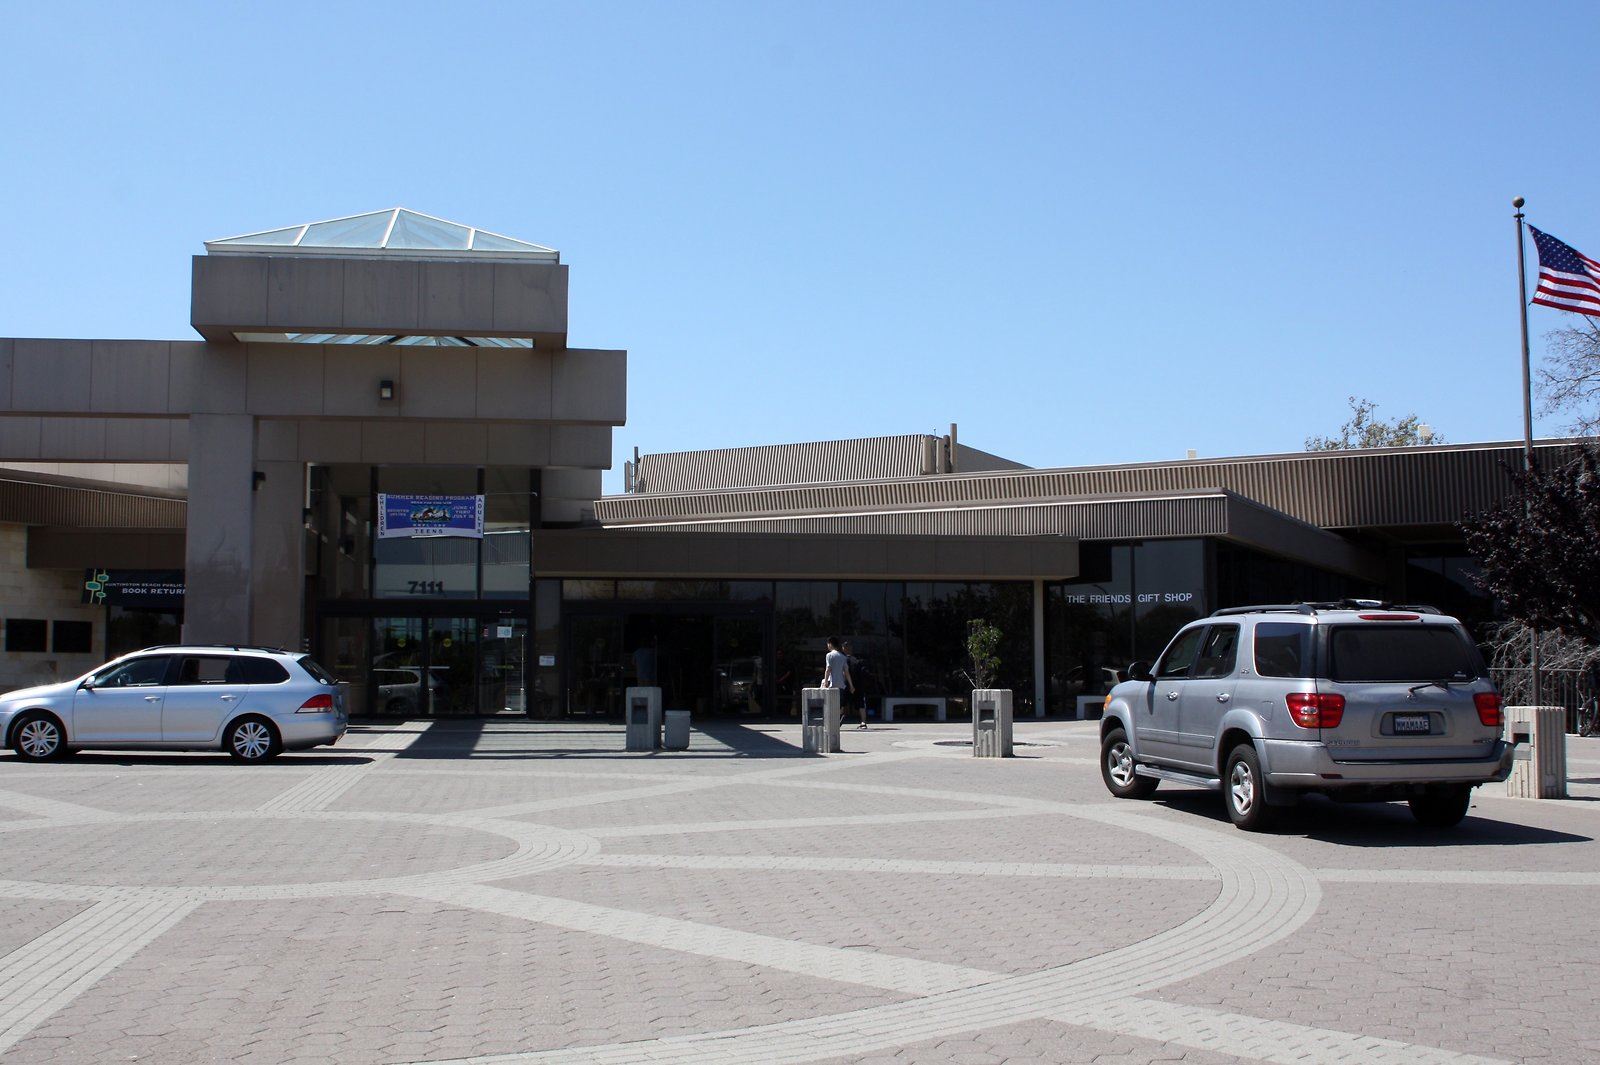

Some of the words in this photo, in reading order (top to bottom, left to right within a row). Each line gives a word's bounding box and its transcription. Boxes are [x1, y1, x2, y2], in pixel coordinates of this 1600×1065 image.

[408, 581, 444, 594] 7111
[1067, 595, 1085, 604] THE
[1090, 594, 1131, 603] FRIENDS
[1138, 593, 1160, 603] GIFT
[1164, 592, 1193, 602] SHOP
